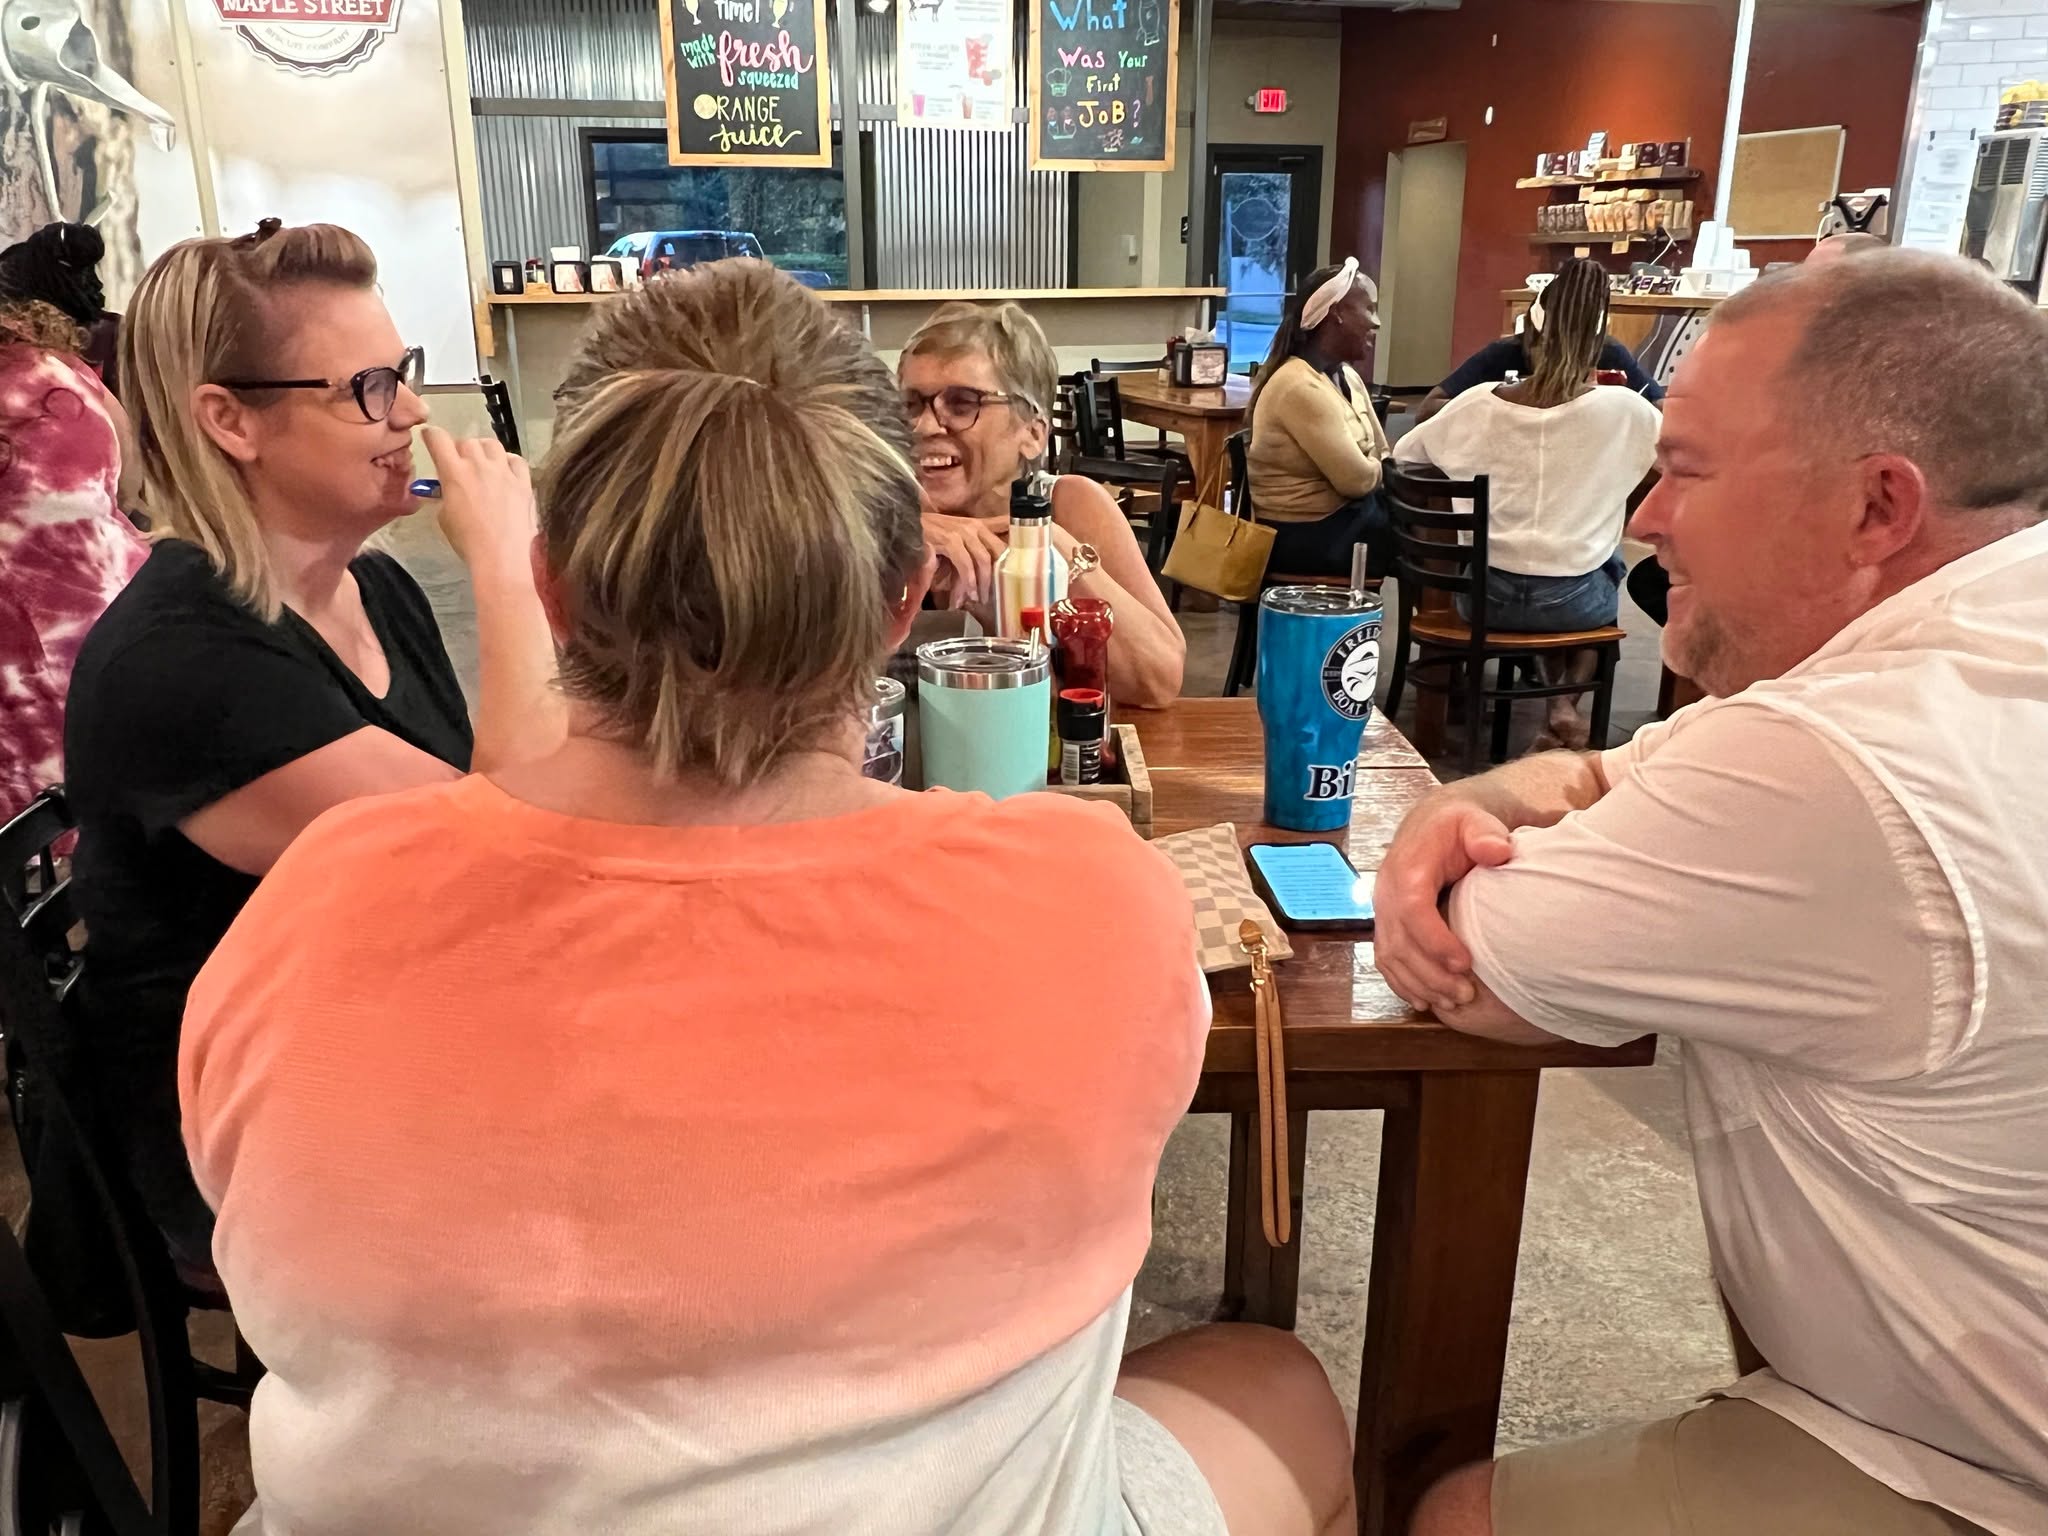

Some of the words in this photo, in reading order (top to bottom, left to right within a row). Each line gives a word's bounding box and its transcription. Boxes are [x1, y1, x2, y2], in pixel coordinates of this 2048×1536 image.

[223, 0, 299, 13] MAPLE
[304, 0, 384, 16] STREET
[1050, 0, 1127, 31] What
[681, 33, 716, 57] made
[687, 51, 716, 69] with
[717, 30, 814, 87] fresh
[1058, 47, 1105, 68] Was
[1118, 51, 1148, 68] Your
[738, 70, 799, 91] squeezed
[1086, 73, 1121, 93] First
[709, 124, 802, 152] juice
[1332, 689, 1363, 715] BOAT
[1303, 760, 1357, 801] Bi
